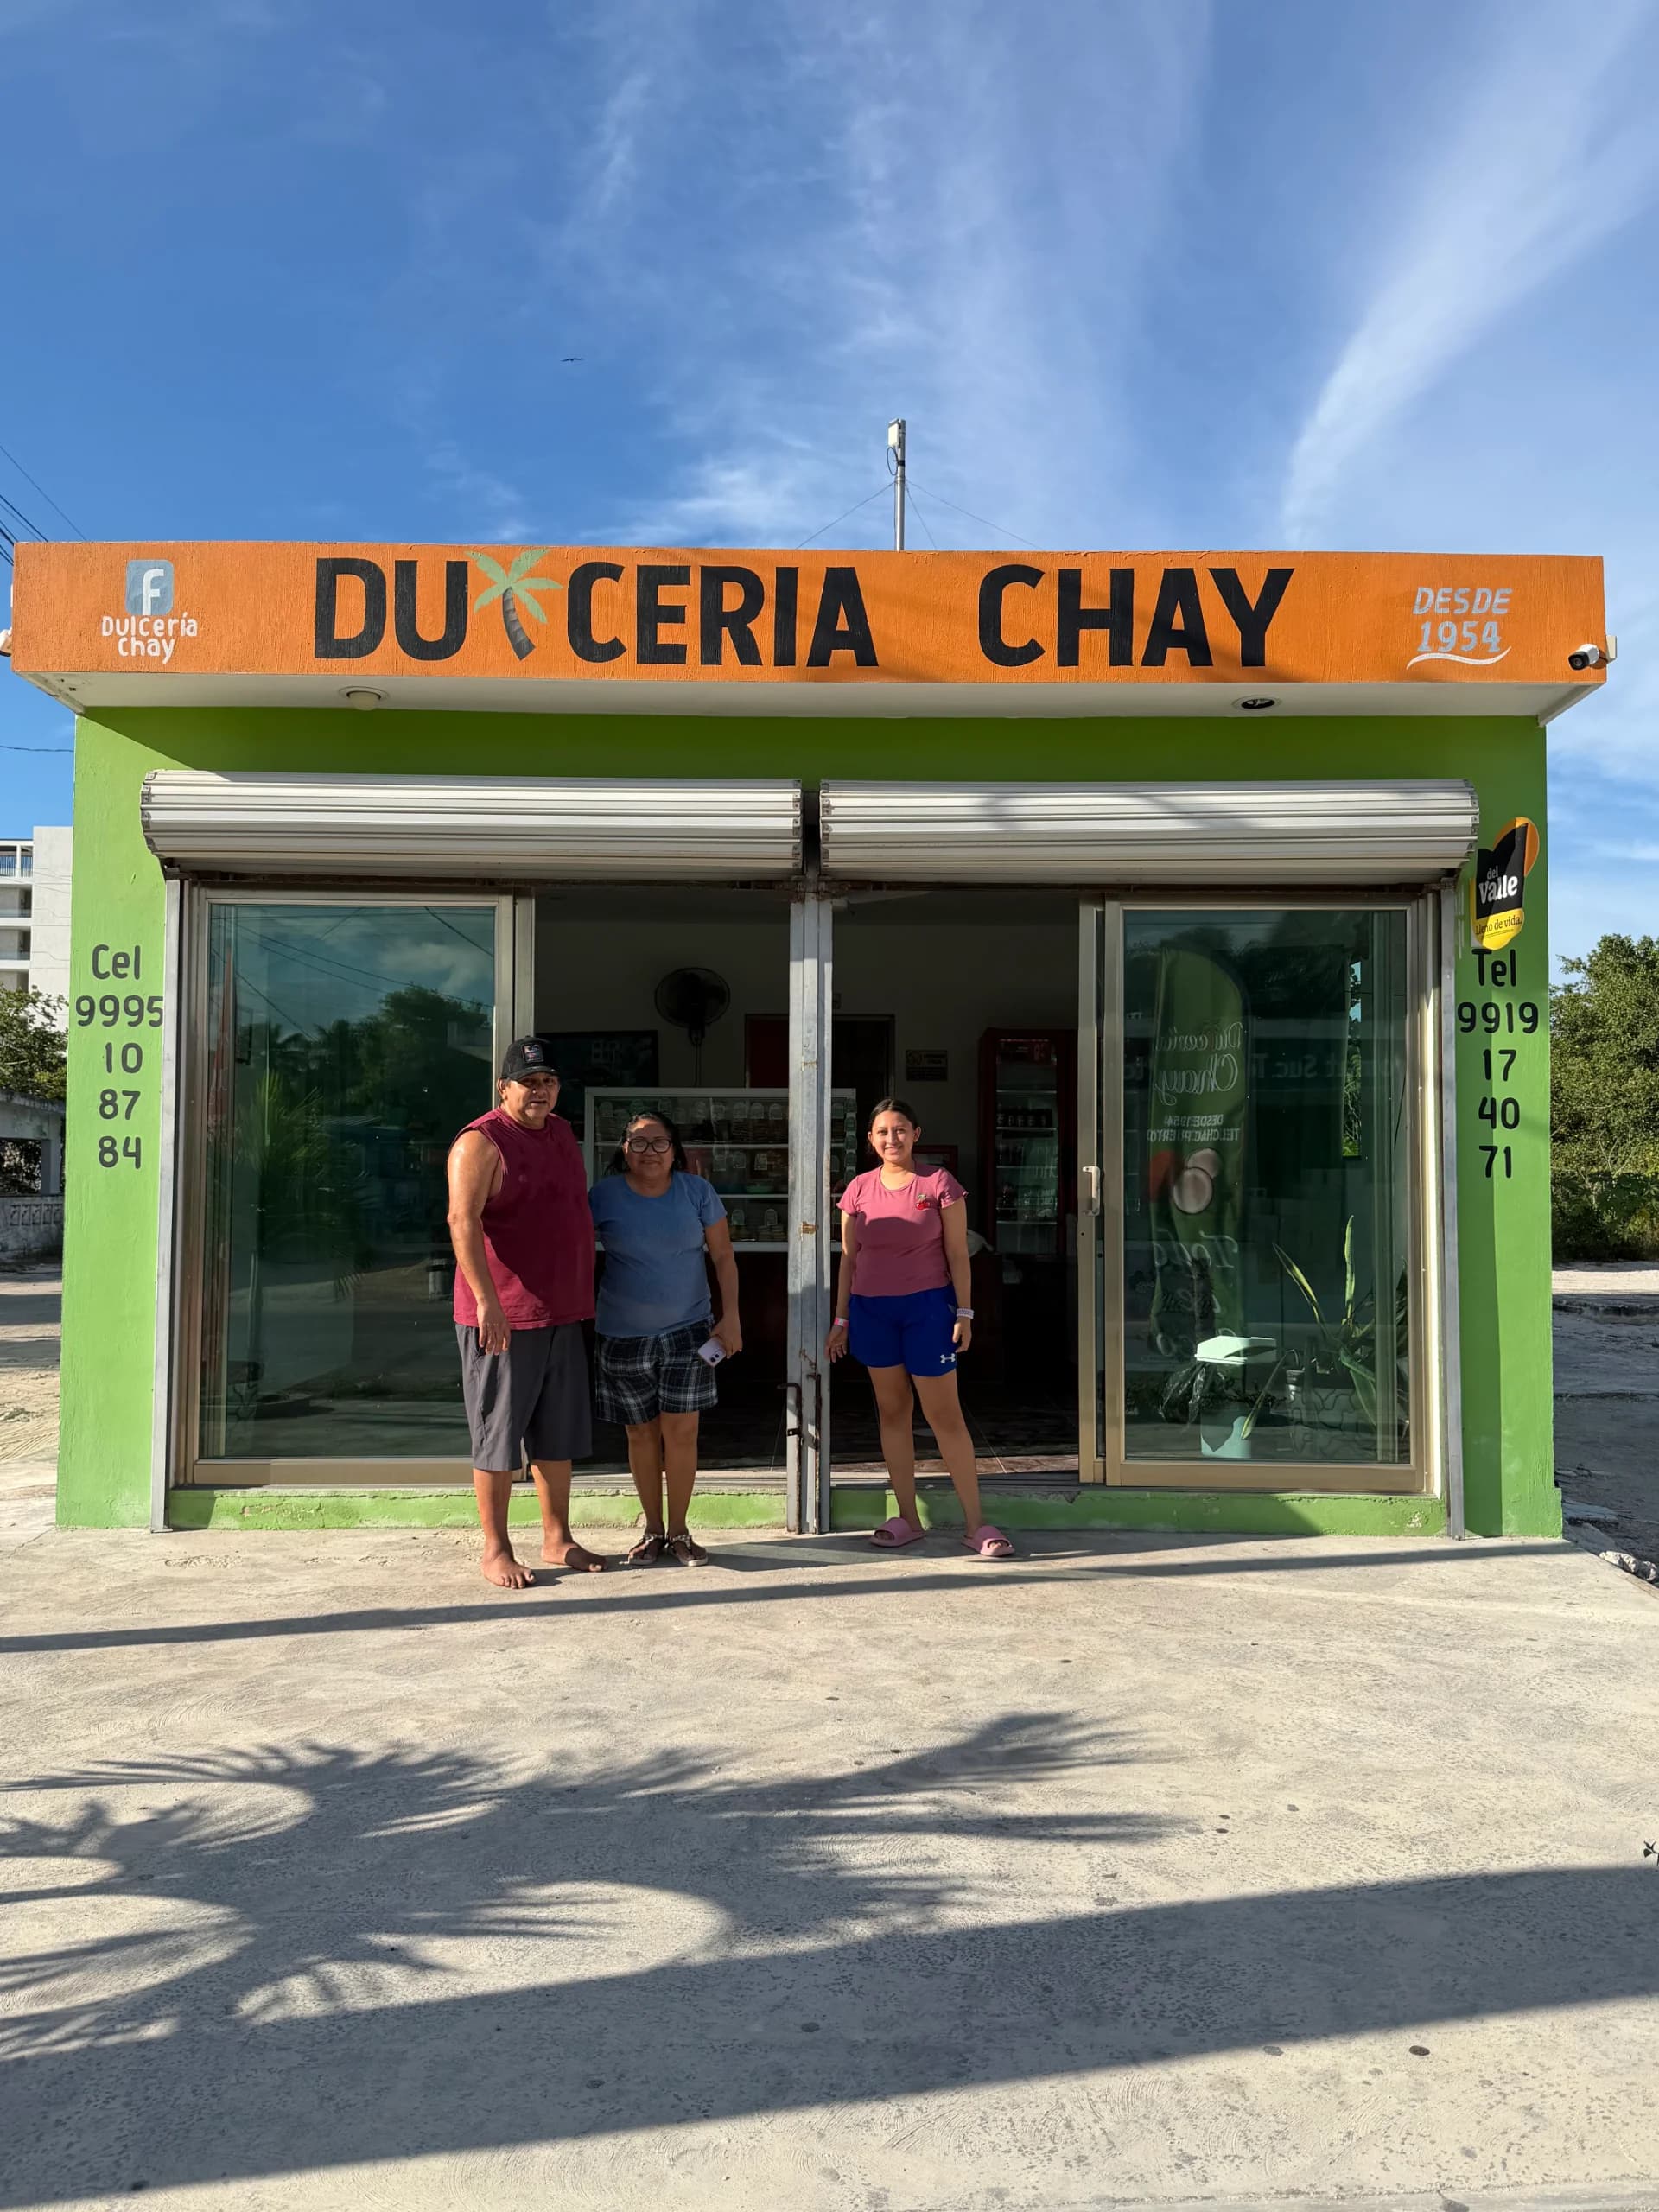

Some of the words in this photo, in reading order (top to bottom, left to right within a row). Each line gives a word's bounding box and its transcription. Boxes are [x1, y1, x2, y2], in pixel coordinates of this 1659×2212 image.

[978, 564, 1295, 667] CHAY
[1413, 587, 1513, 615] DESDE
[1417, 620, 1502, 652] 1954
[1486, 865, 1498, 880] del
[1478, 874, 1518, 905] Valle
[1494, 918, 1503, 931] de
[92, 944, 141, 980] Cel
[1471, 949, 1516, 988] Tel
[75, 995, 164, 1027] 9995
[1457, 1001, 1539, 1033] 9919
[105, 1042, 143, 1074] 10
[1483, 1048, 1516, 1081] 17
[99, 1089, 141, 1121] 87
[1478, 1097, 1521, 1130] 40
[99, 1135, 142, 1169] 84
[1478, 1146, 1513, 1179] 71
